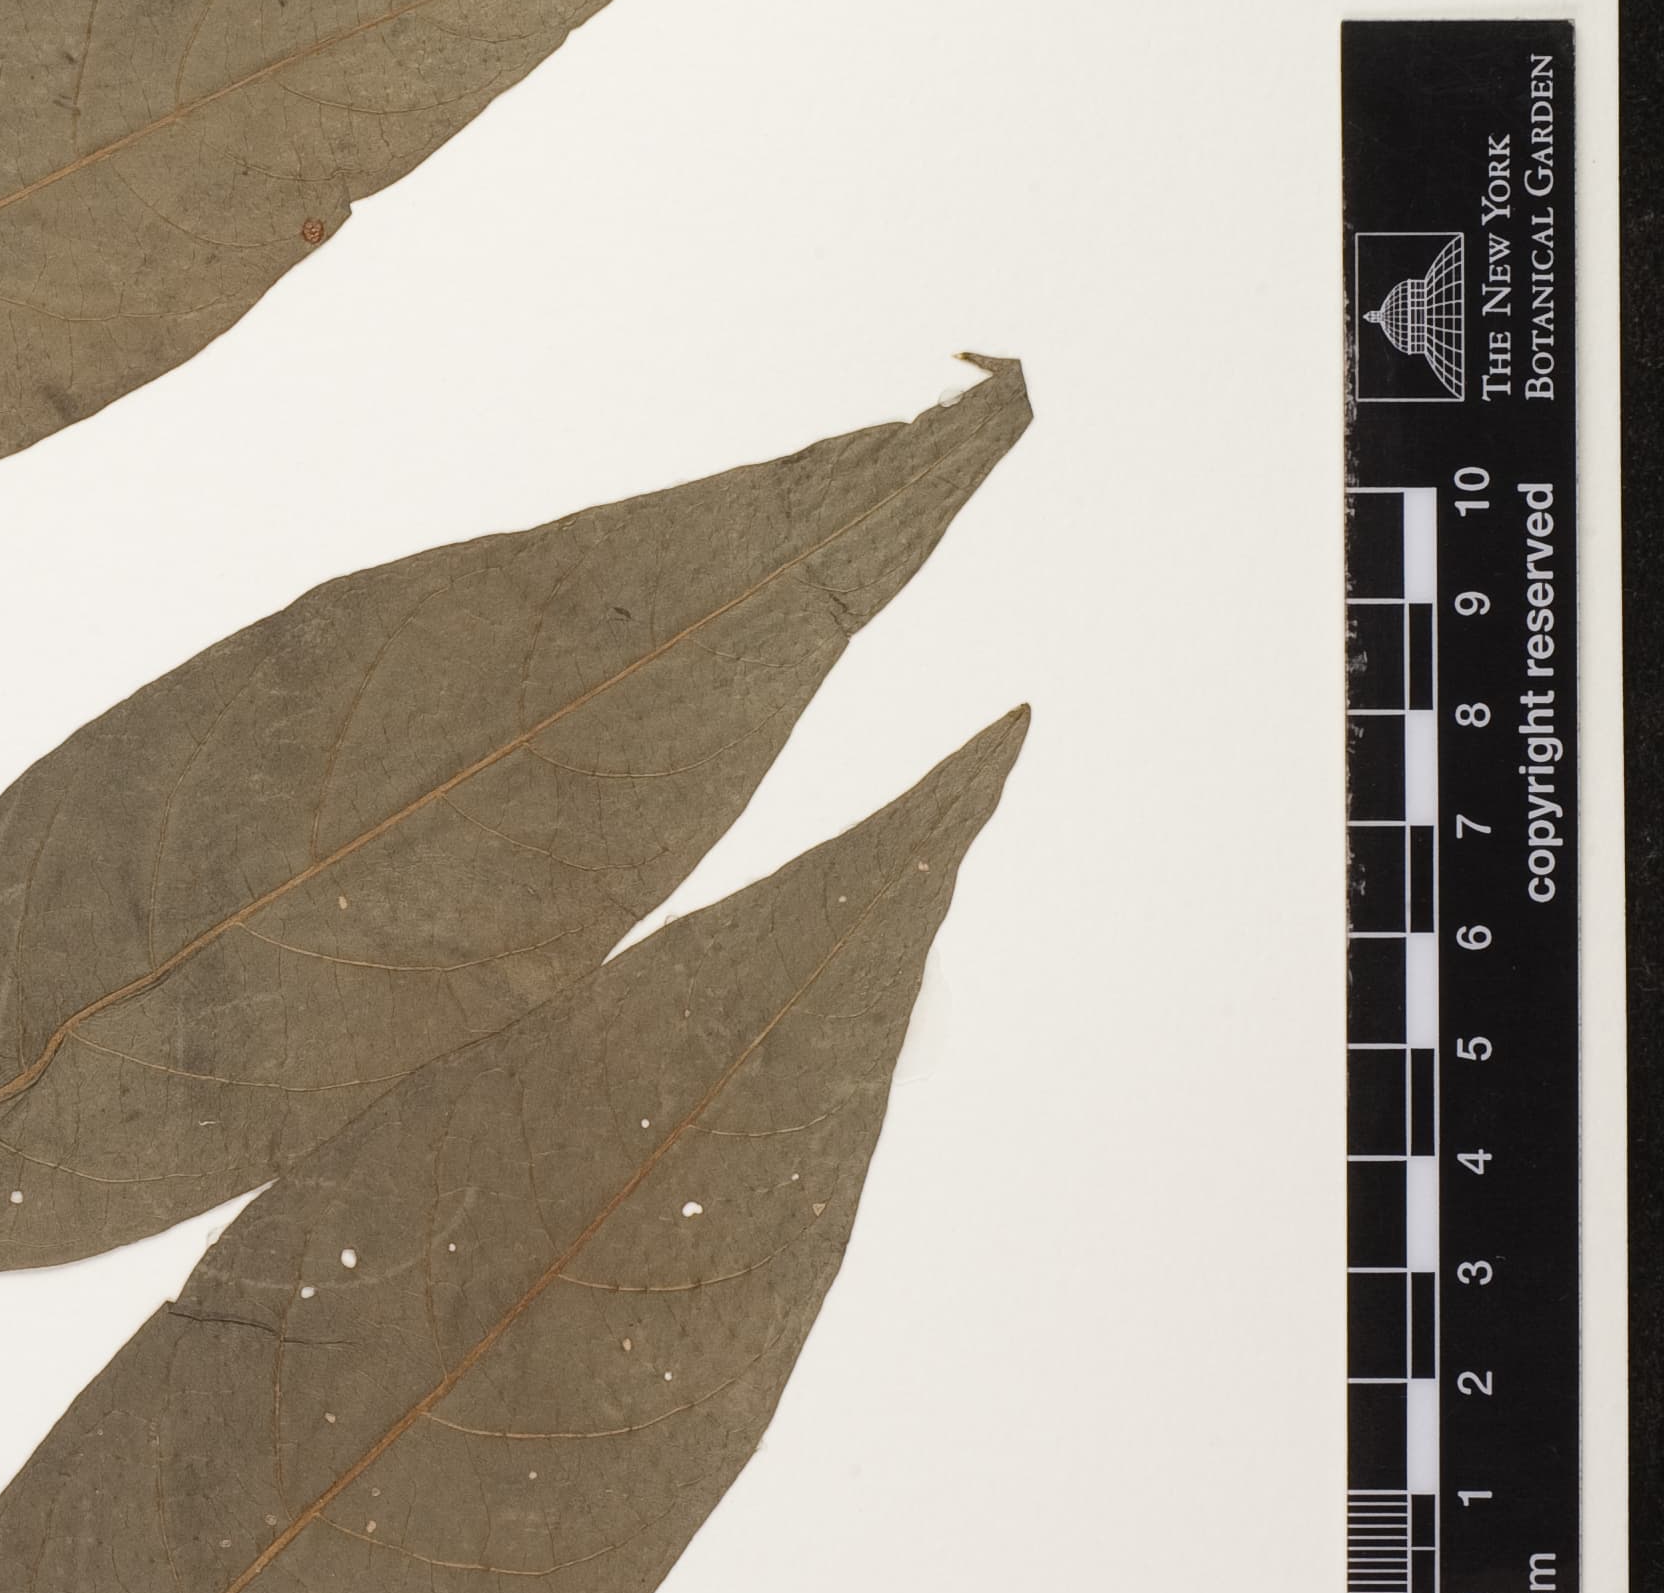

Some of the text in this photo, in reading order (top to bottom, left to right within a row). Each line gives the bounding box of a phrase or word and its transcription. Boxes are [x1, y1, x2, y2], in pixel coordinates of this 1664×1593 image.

[1522, 52, 1556, 402] BOTANICAL GARDEN
[1480, 133, 1513, 403] THE NEW YORK
[1452, 465, 1491, 518] 10
[1453, 590, 1492, 617] 9
[1516, 482, 1565, 904] copyright reserved
[1453, 701, 1492, 729] 8
[1454, 813, 1493, 840] 7
[1454, 923, 1493, 952] 6
[1455, 1035, 1494, 1062] 5
[1455, 1147, 1494, 1176] 4
[1455, 1259, 1494, 1287] 3
[1456, 1369, 1494, 1397] 2
[1456, 1489, 1494, 1508] 1
